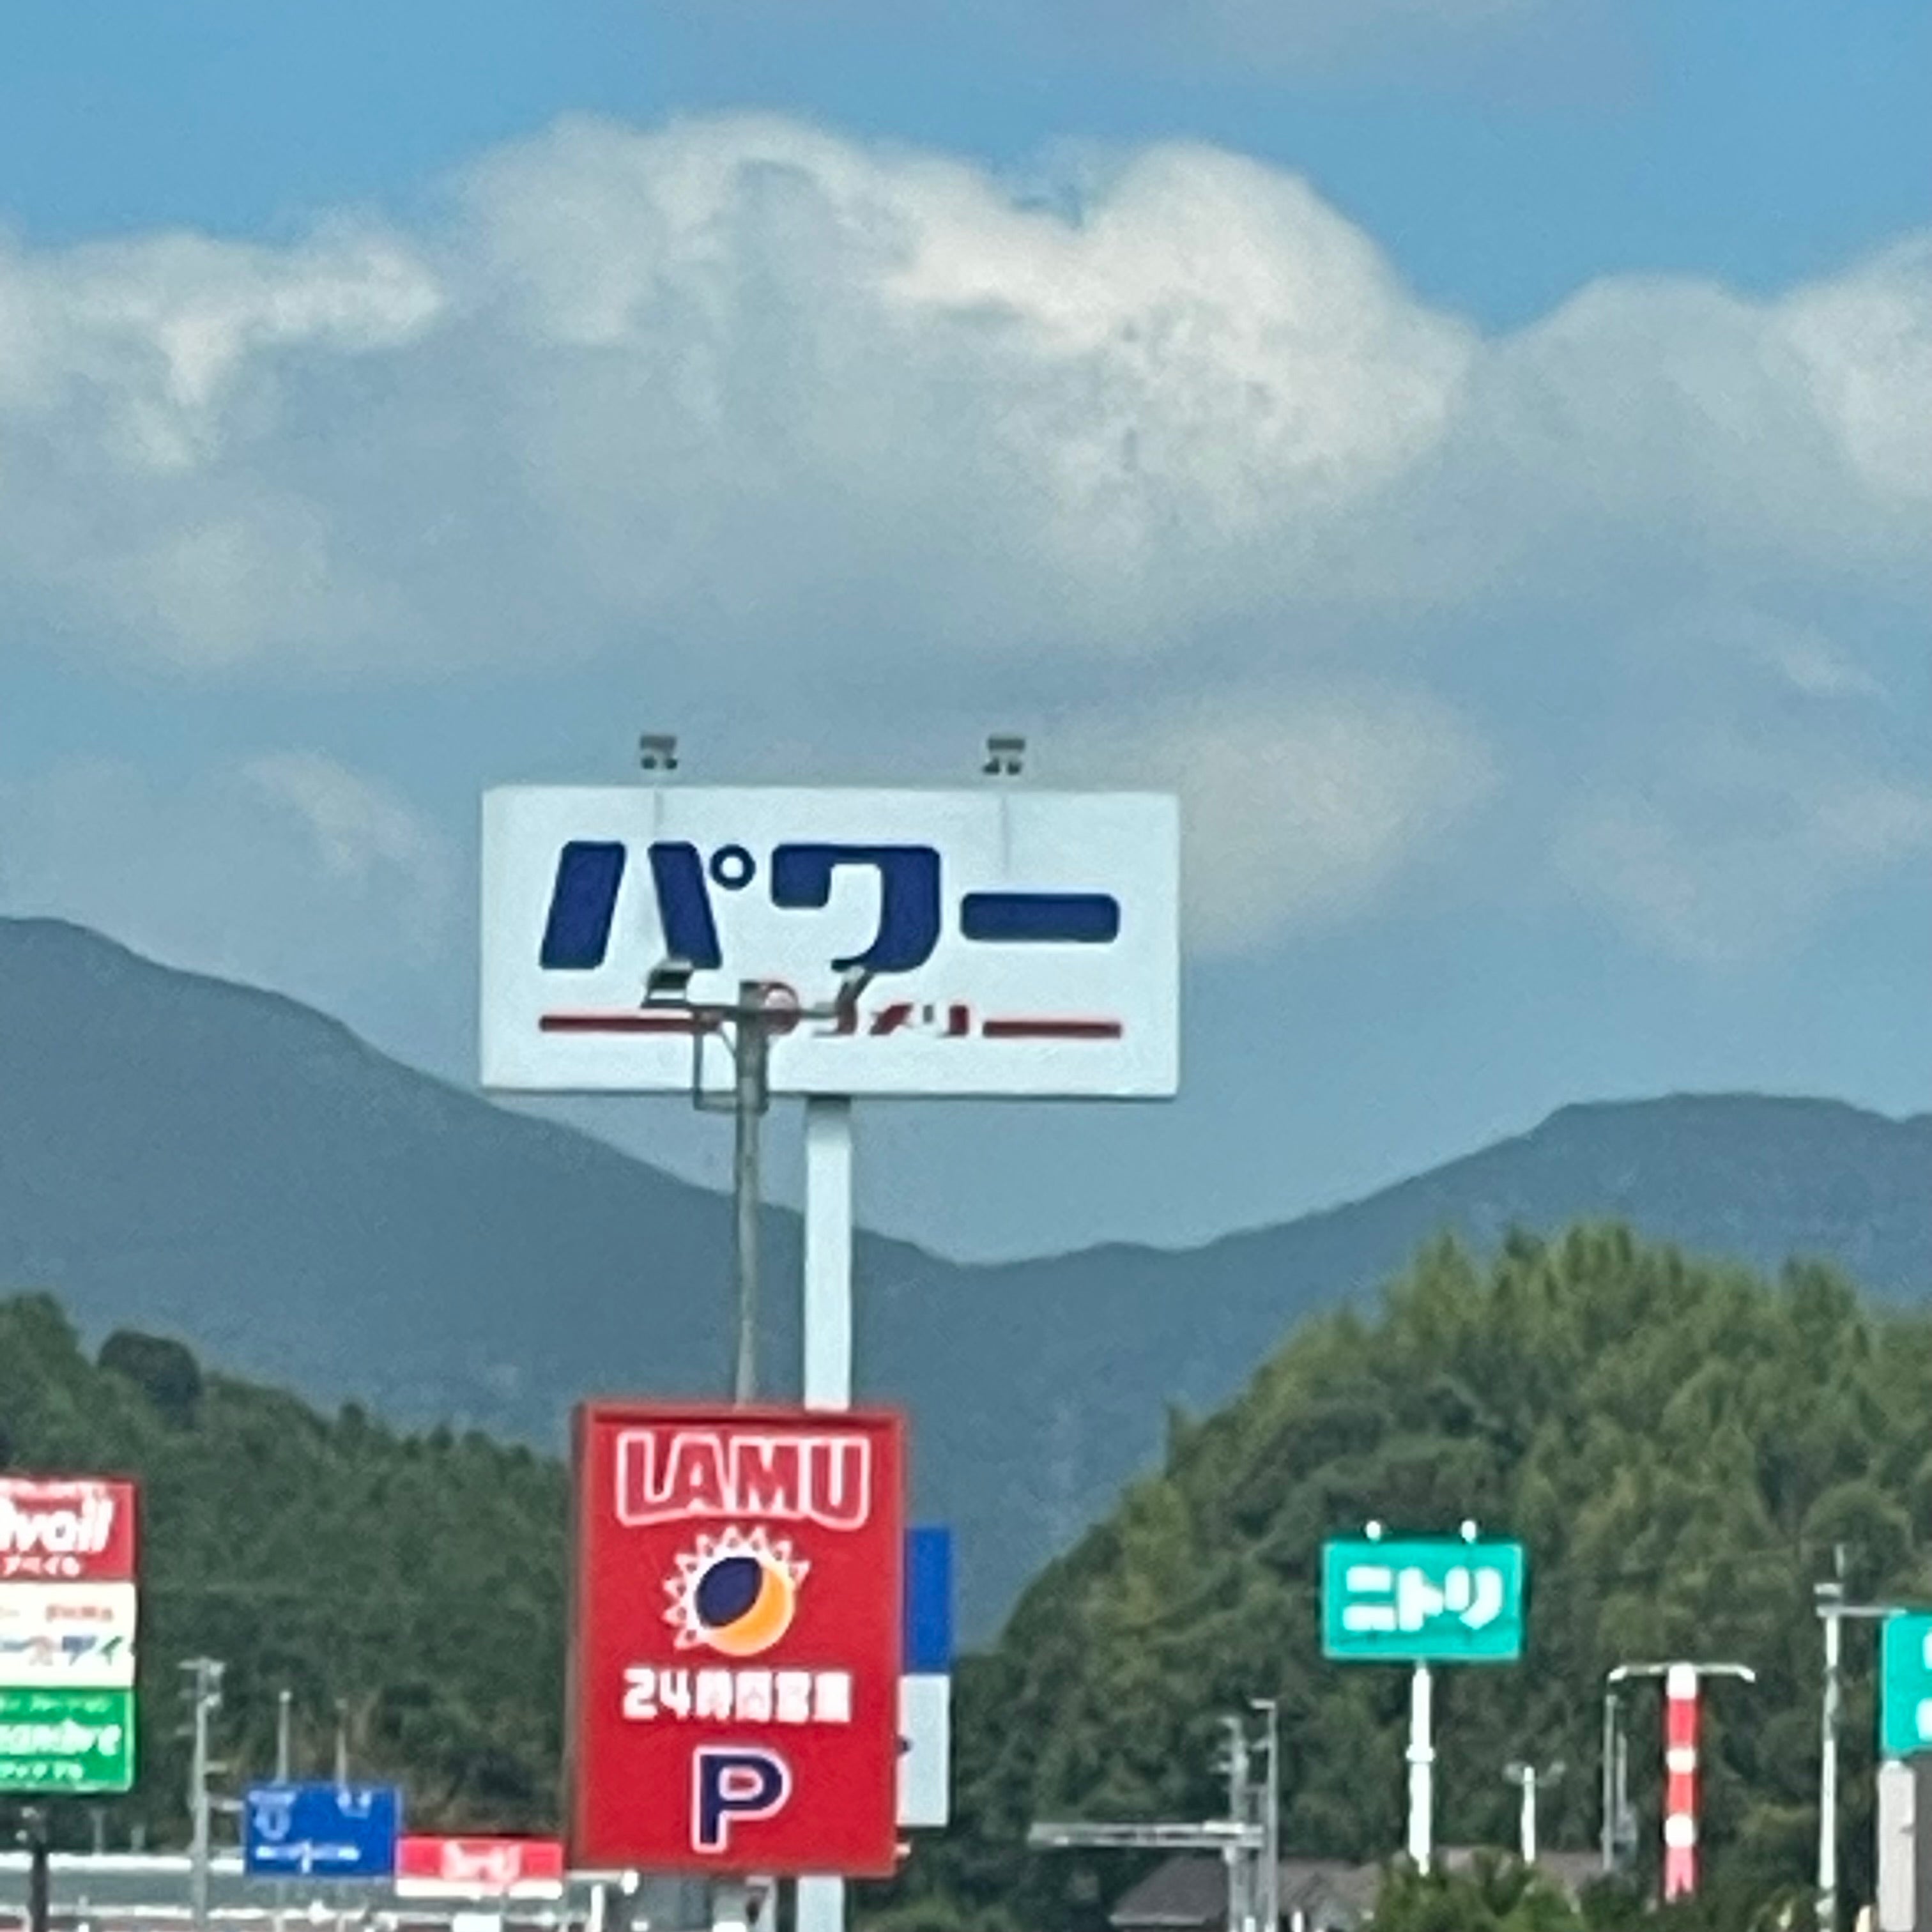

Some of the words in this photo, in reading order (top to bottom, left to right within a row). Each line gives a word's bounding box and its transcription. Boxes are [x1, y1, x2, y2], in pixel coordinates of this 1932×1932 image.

[540, 841, 1121, 971] パワー
[616, 1431, 871, 1529] LAMU
[1342, 1566, 1503, 1632] ニトリ
[691, 1745, 792, 1853] P
